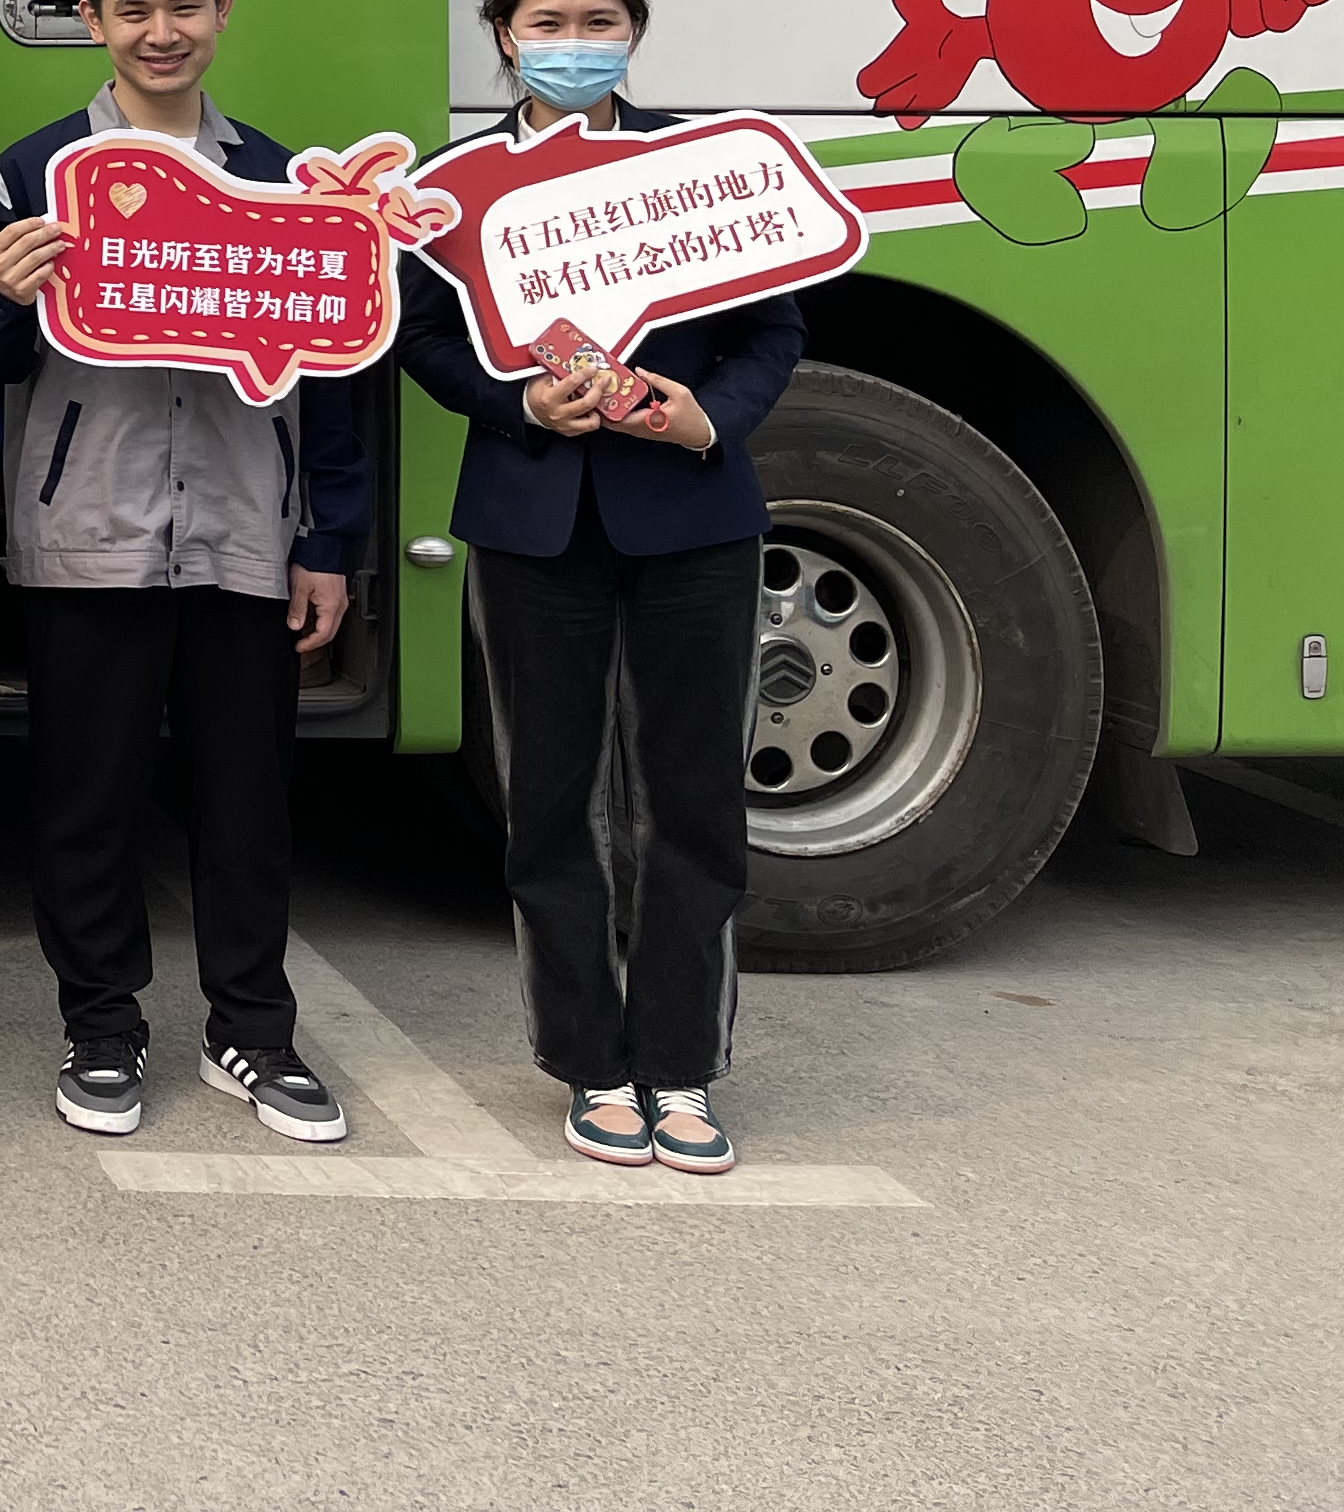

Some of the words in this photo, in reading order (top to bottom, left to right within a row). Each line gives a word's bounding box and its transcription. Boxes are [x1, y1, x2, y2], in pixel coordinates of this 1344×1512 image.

[494, 160, 787, 260] 有五星红旗的地方
[100, 236, 348, 281] 目光所至皆为华夏
[515, 206, 806, 306] 就有信念的灯塔！
[95, 282, 347, 325] 五星闪耀皆为信仰
